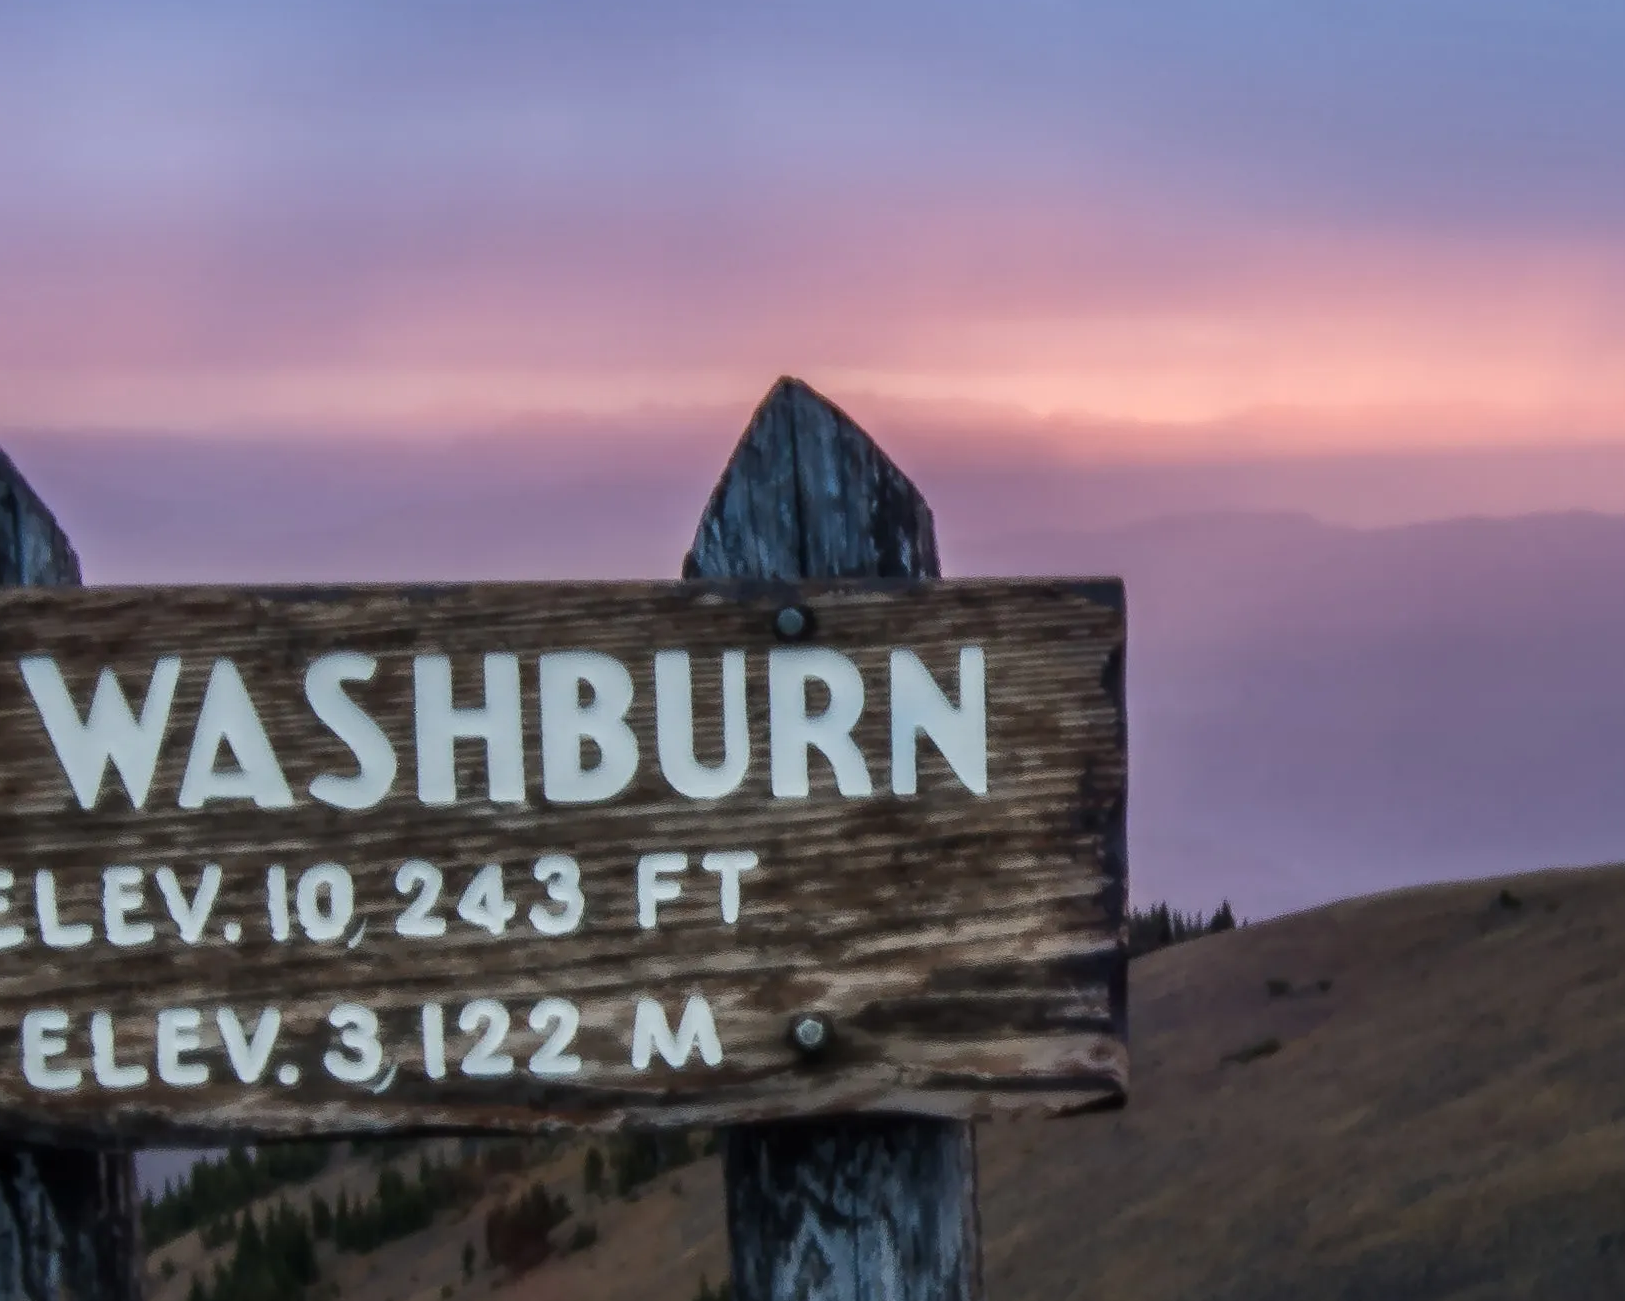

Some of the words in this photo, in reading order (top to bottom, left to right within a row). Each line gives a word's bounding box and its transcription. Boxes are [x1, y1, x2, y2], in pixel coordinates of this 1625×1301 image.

[21, 647, 991, 812] WASHBURN
[267, 854, 585, 949] 10,243
[637, 850, 759, 931] FT
[23, 1007, 299, 1091] ELEV.
[324, 998, 590, 1092] 3,122
[631, 992, 724, 1072] M
